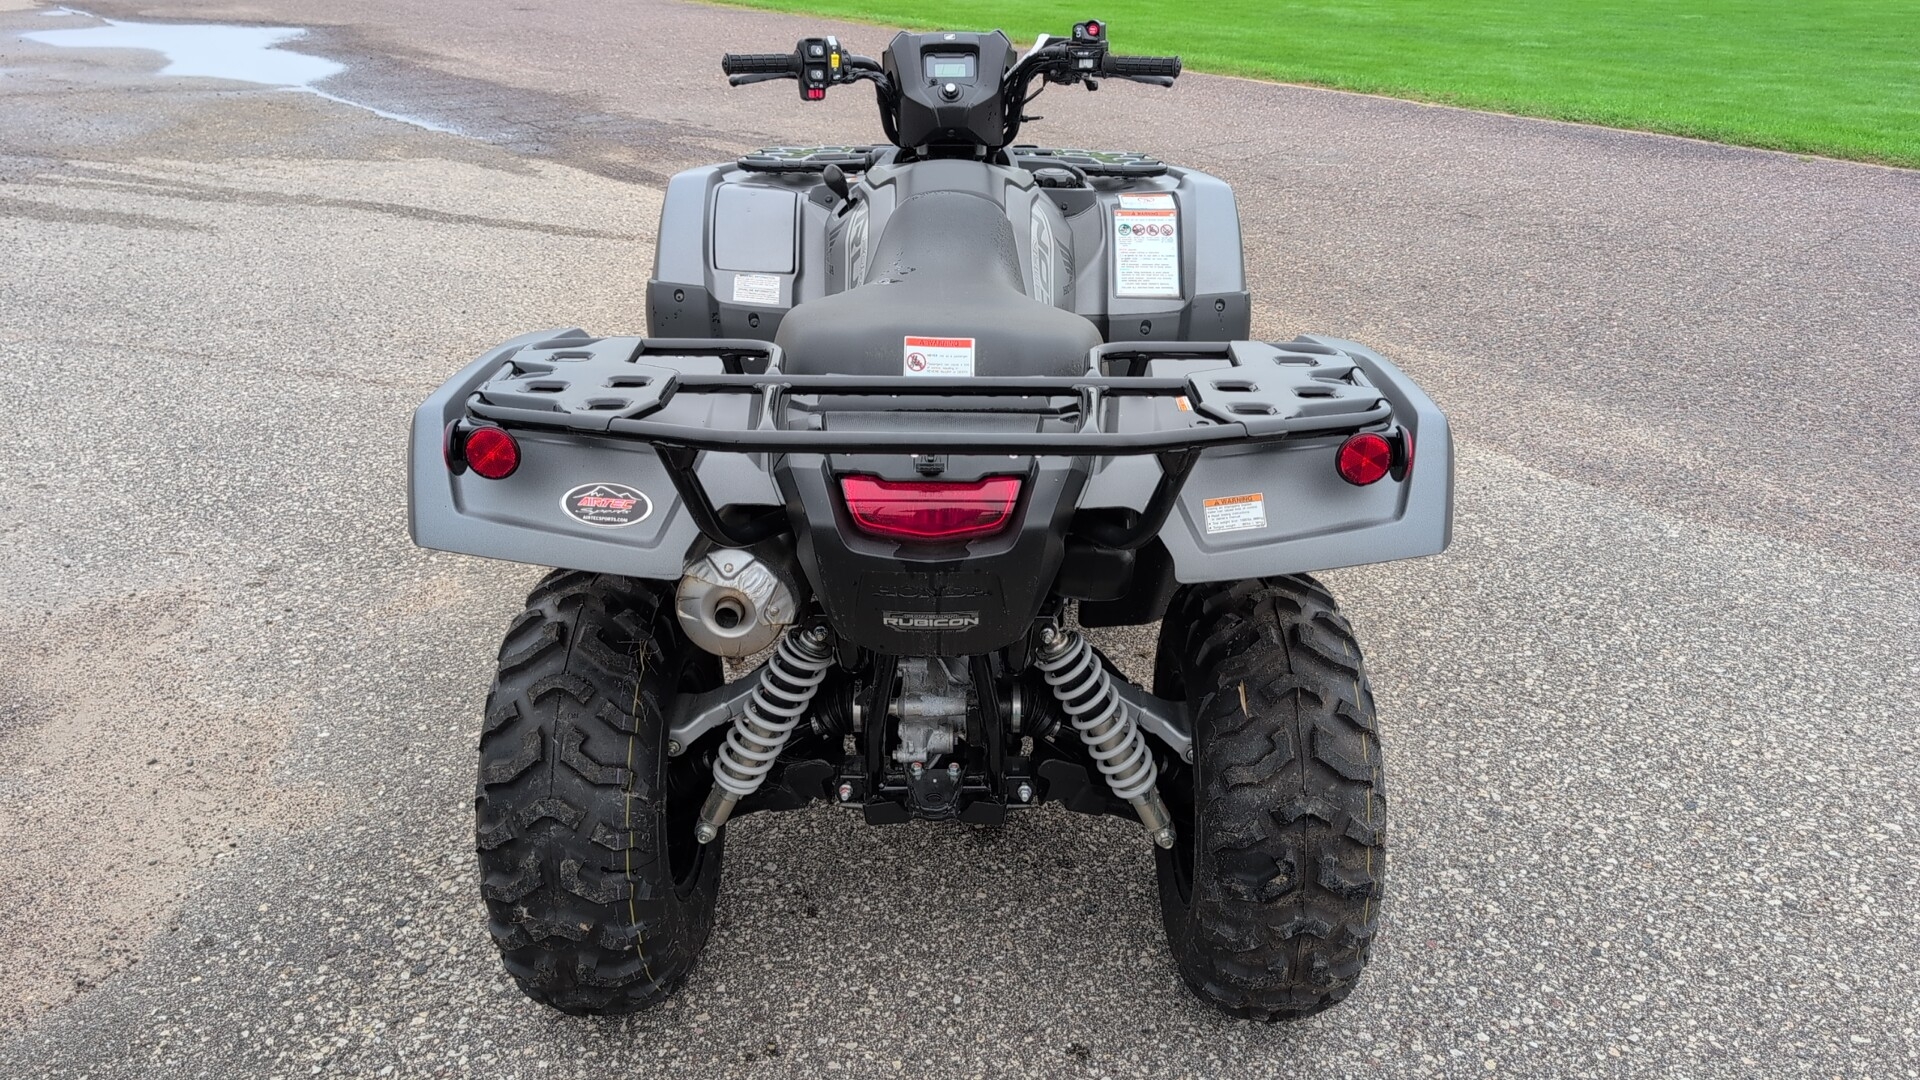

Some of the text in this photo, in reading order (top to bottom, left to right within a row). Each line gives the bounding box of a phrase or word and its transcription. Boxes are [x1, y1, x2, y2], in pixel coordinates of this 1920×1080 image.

[1220, 495, 1253, 505] WARNING
[582, 515, 628, 523] AIRTECSPORTS.COM
[883, 617, 979, 627] RUBICON
